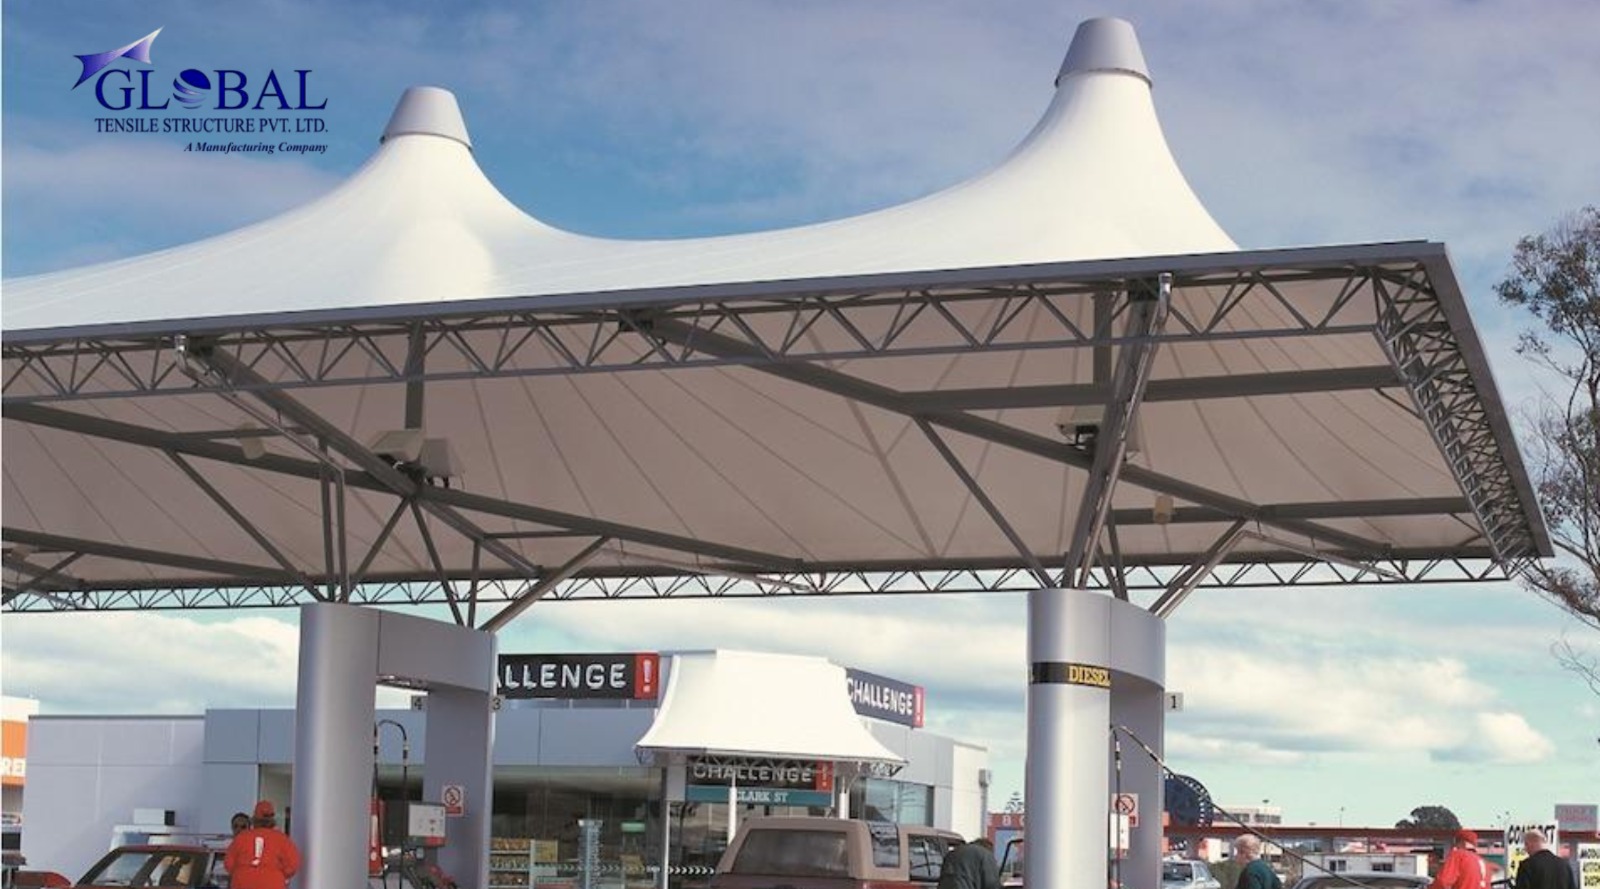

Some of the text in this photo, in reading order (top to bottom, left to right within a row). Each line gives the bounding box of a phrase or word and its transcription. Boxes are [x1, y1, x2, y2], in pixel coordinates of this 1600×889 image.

[1068, 665, 1111, 687] DIESEL
[414, 696, 422, 711] 4
[492, 697, 501, 711] 3
[1171, 695, 1177, 709] 1
[773, 792, 789, 803] ST
